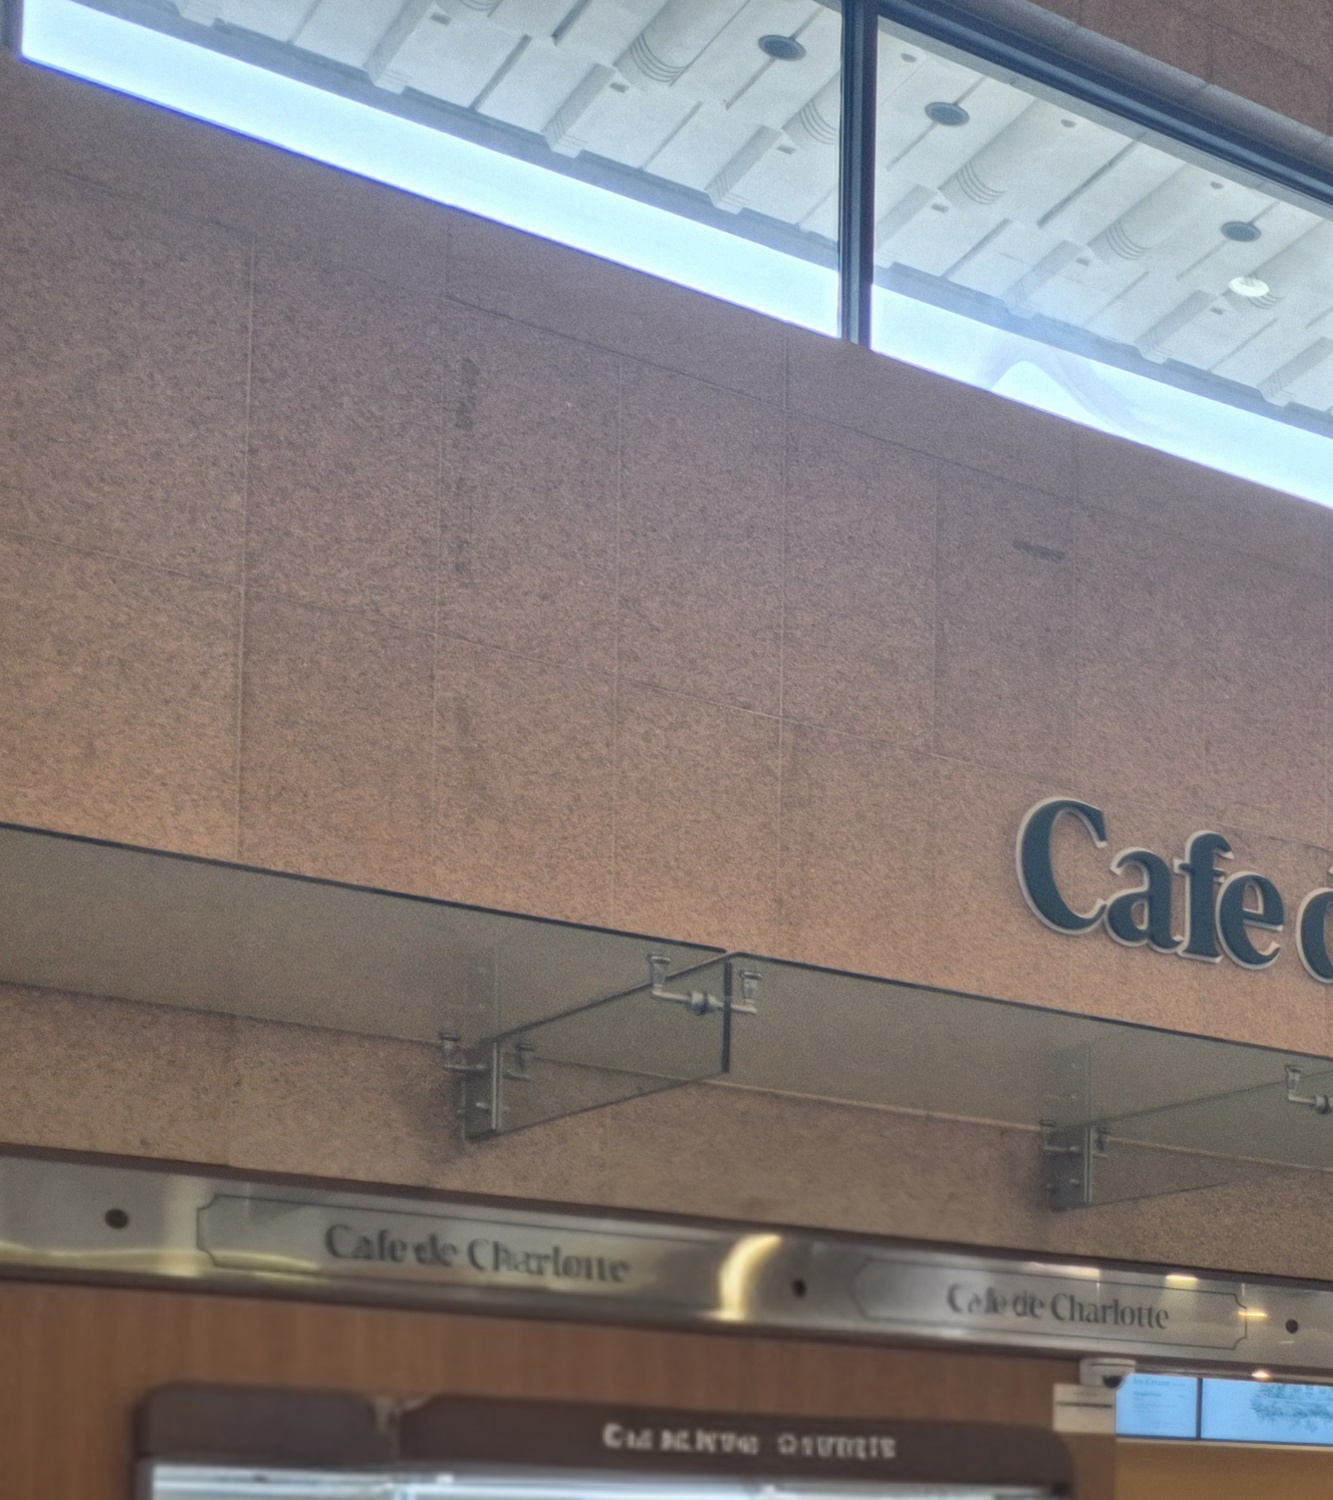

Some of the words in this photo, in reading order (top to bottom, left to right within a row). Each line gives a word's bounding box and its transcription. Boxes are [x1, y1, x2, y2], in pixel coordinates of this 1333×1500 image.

[1015, 797, 1284, 968] Cafe
[324, 1224, 406, 1263] Cafe
[413, 1234, 458, 1266] de
[1012, 1290, 1044, 1319] de
[1051, 1292, 1169, 1329] Charlotte
